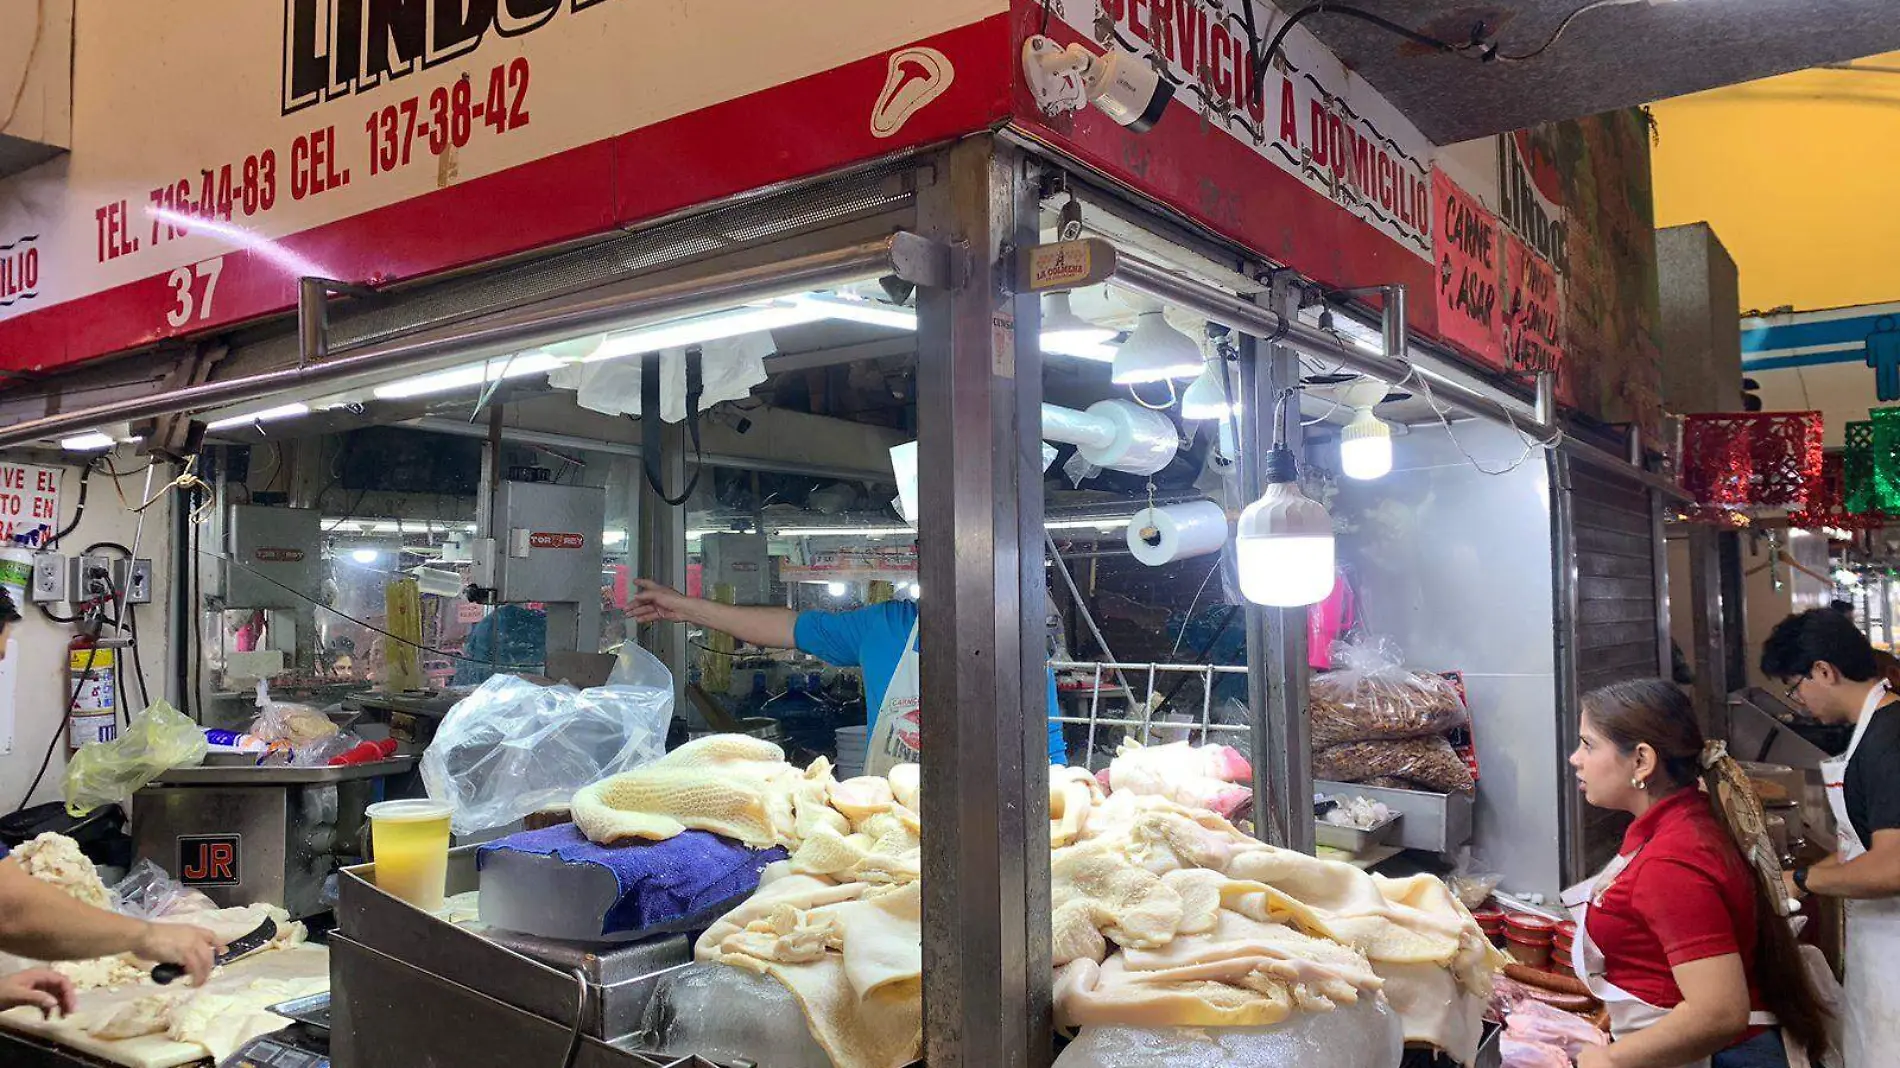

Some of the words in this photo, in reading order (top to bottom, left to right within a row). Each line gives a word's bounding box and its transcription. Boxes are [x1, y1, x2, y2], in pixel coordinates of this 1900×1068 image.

[95, 199, 139, 263] TEL.
[149, 148, 276, 246] 716-44-83
[291, 125, 350, 200] CEL.
[365, 56, 530, 176] 137-38-42
[1280, 77, 1298, 149] A
[1311, 98, 1429, 236] DOMICILIO
[1445, 195, 1492, 269] CARNE
[167, 256, 223, 327] 37
[0, 467, 25, 490] VE
[37, 471, 56, 493] EL
[32, 497, 54, 519] EN
[530, 536, 552, 544] TOR
[563, 536, 583, 545] REY
[184, 843, 233, 879] JR
